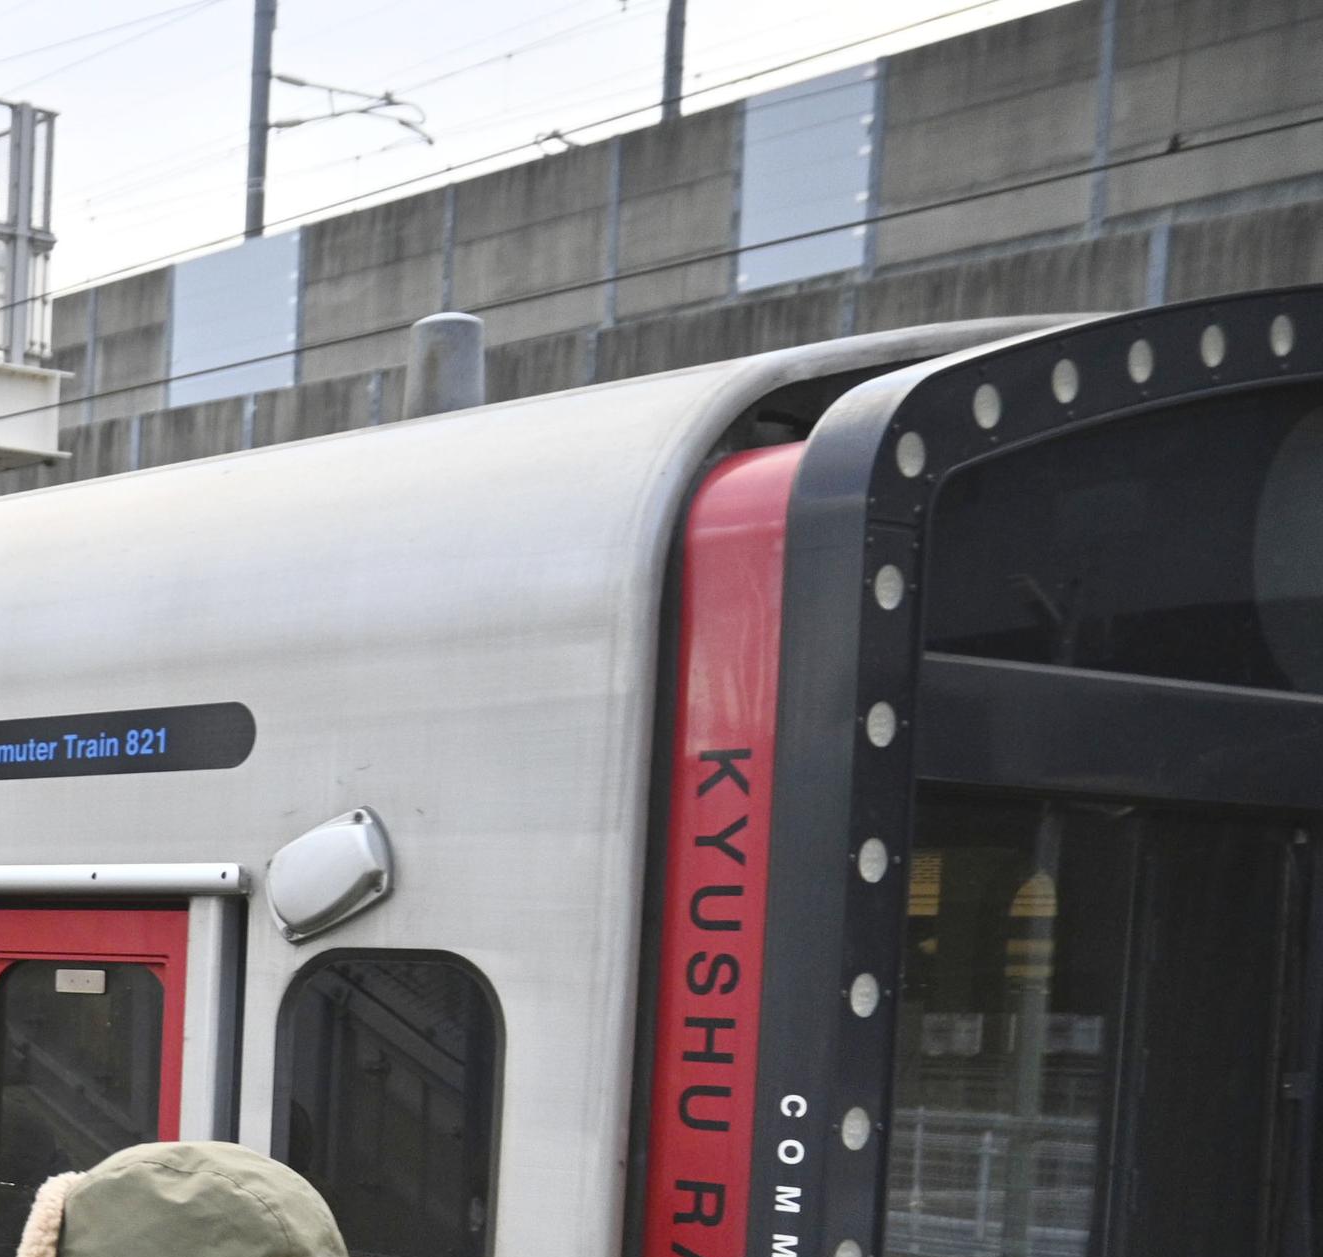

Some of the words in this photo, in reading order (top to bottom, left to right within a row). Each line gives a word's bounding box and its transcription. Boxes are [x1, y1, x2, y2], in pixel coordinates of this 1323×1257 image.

[63, 732, 120, 759] Train
[125, 727, 167, 756] 821
[677, 747, 753, 1132] KYUSHU
